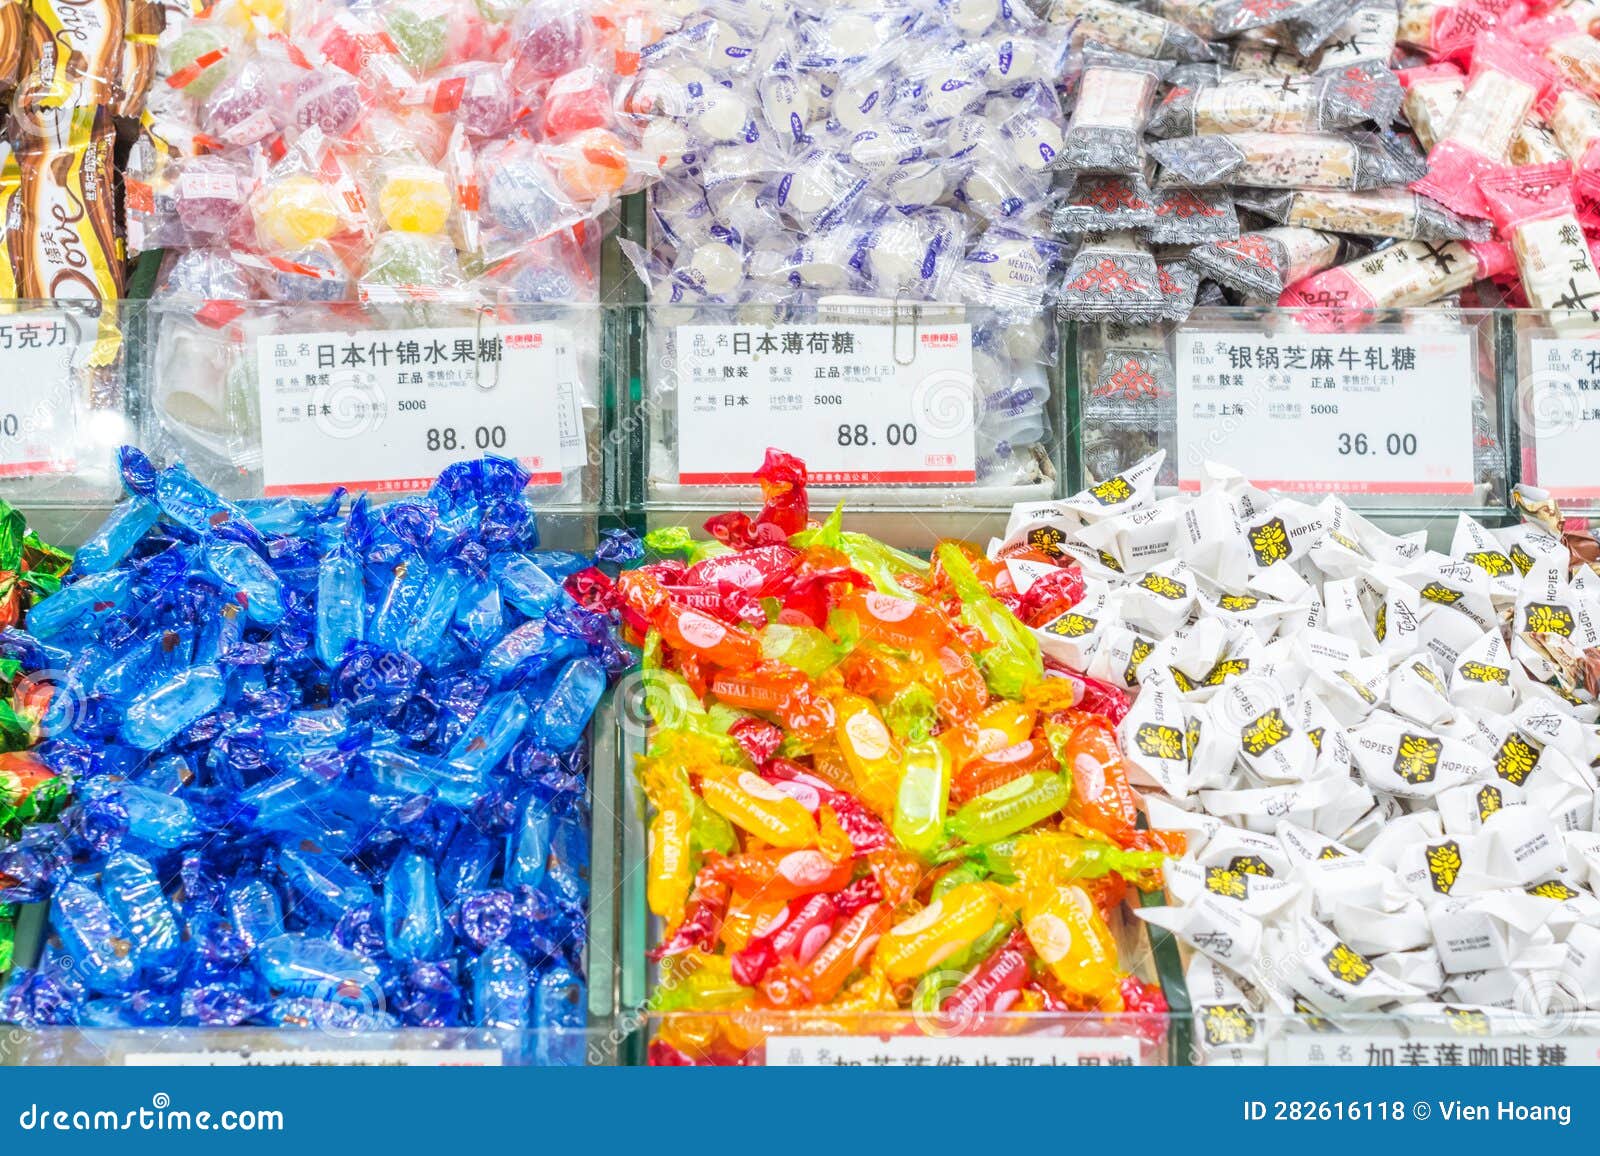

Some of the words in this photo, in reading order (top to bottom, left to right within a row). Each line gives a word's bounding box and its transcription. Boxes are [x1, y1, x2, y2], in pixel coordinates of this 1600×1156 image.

[1009, 271, 1035, 284] CANDY
[733, 333, 855, 355] 日本薄荷糖
[318, 338, 502, 368] 日本什锦水果糖
[1228, 346, 1417, 371] 银锅芝麻牛轧糖
[306, 374, 330, 386] 散装
[397, 372, 423, 384] 正品
[724, 366, 749, 378] 散装
[814, 367, 840, 378] 正品
[1219, 374, 1244, 386] 散装
[1311, 376, 1336, 389] 正品
[398, 400, 427, 411] 500G
[725, 395, 749, 406] 日本
[814, 396, 842, 405] 500G
[307, 404, 331, 416] 日本
[1219, 403, 1244, 416] 上海
[1310, 404, 1339, 415] 500G
[427, 426, 506, 451] 88.00
[837, 424, 917, 446] 88.00
[1338, 433, 1417, 455] 36.00
[1290, 519, 1323, 539] HOPJES
[1547, 568, 1559, 602] HOPJES
[687, 592, 721, 609] FRUI
[1307, 601, 1321, 628] OPJES
[1456, 601, 1486, 626] HOPJES
[1231, 684, 1257, 717] HOPJES
[1359, 739, 1394, 756] HOPJES
[1442, 759, 1479, 775] HOPJES
